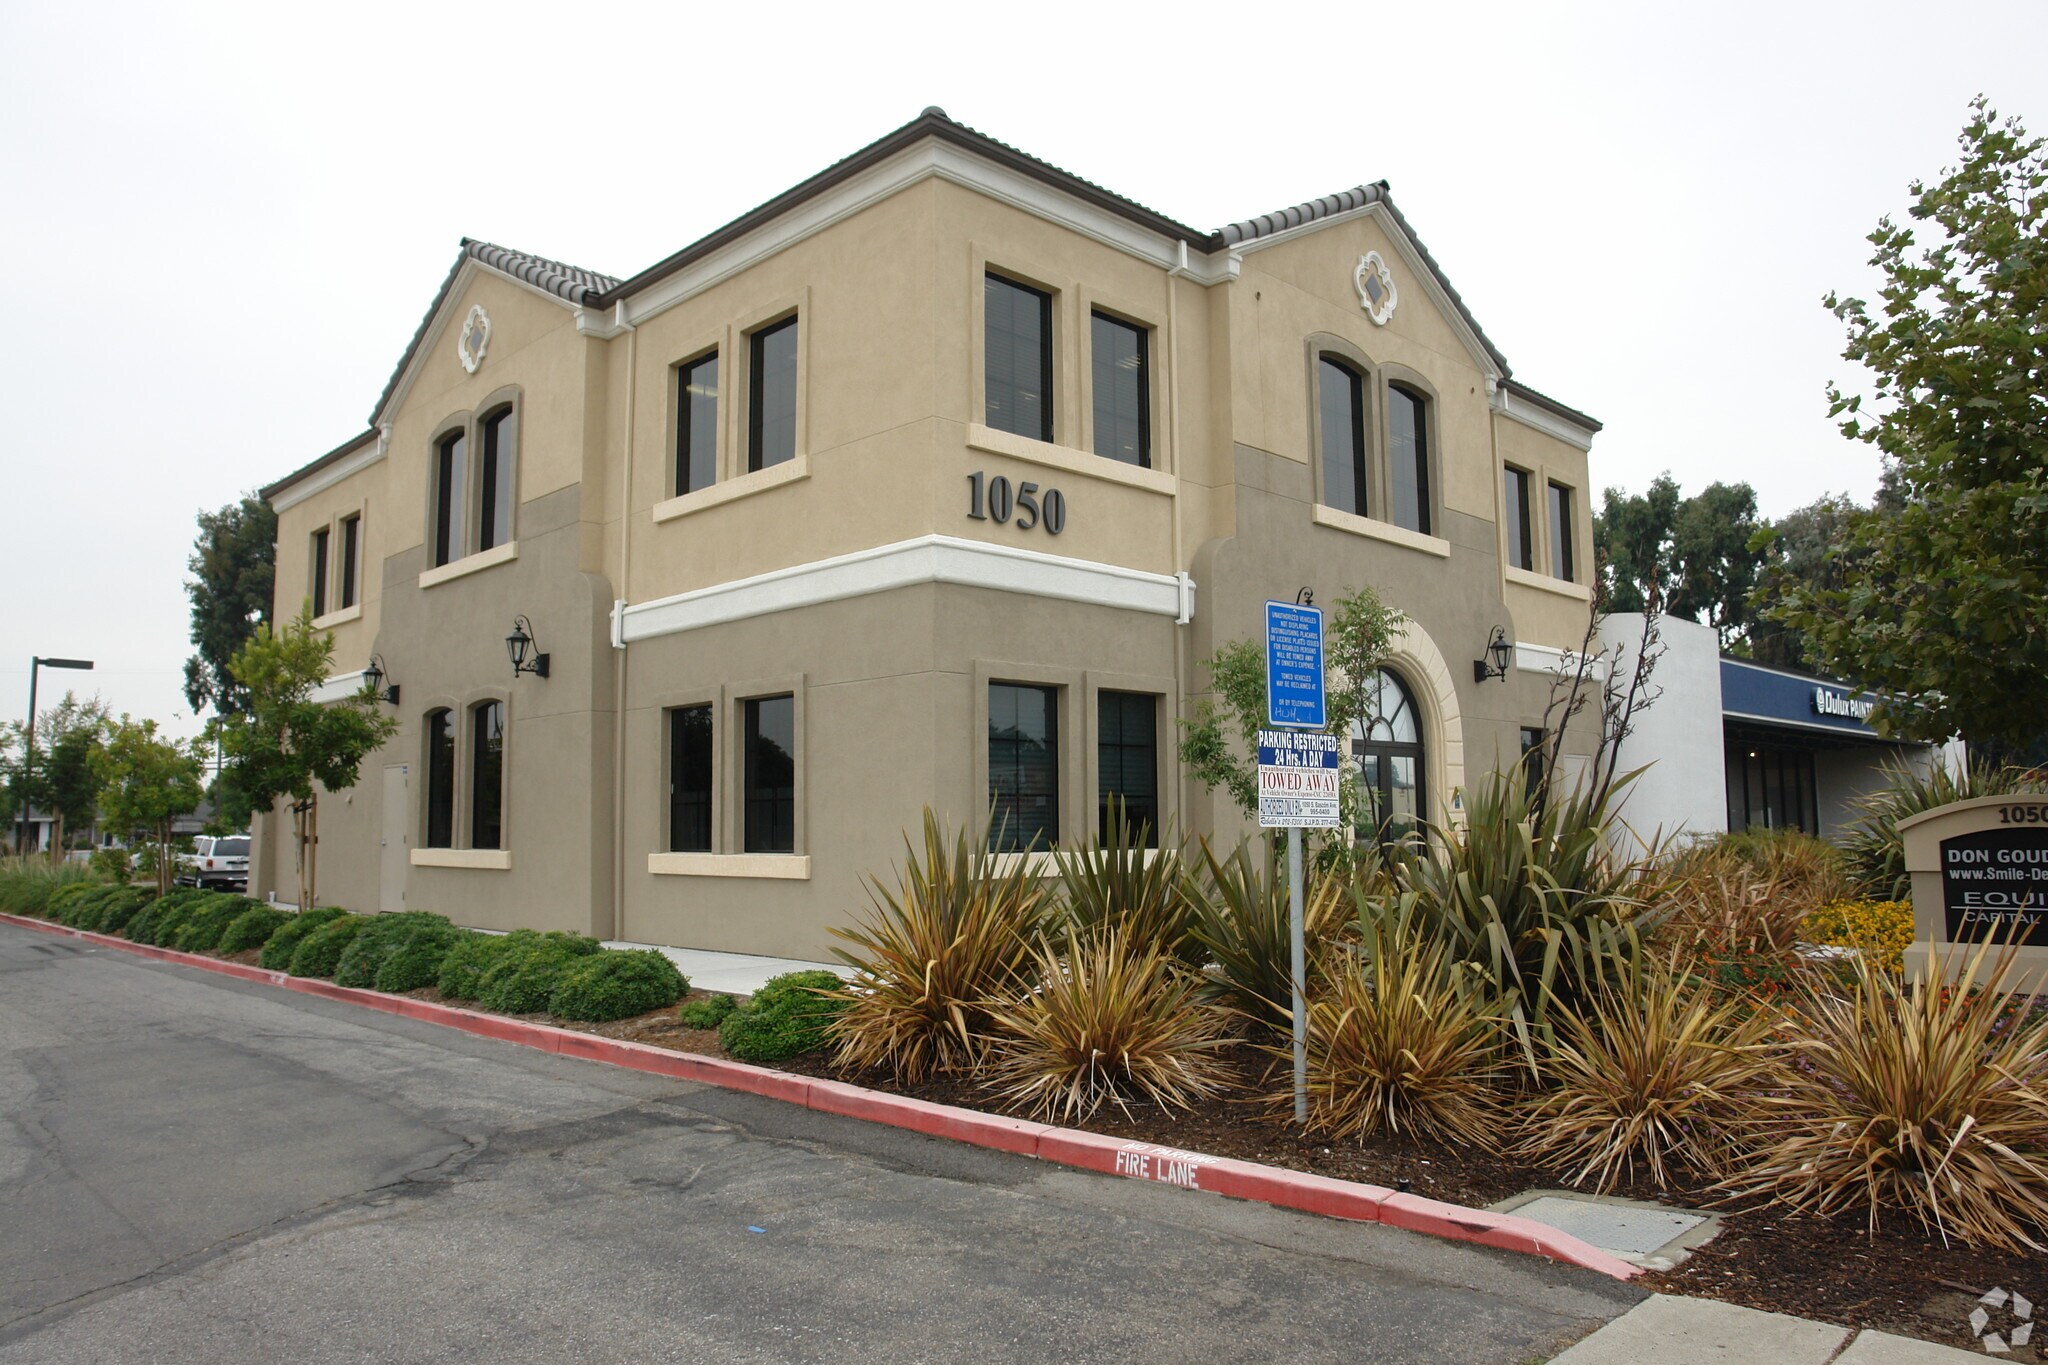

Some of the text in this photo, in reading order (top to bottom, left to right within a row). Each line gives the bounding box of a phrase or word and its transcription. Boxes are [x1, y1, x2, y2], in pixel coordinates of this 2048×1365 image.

[967, 471, 1066, 535] 1050
[1272, 611, 1317, 624] UNAUTHORIZED VEHICLES
[1288, 621, 1309, 630] DISPLAYING
[1271, 627, 1318, 639] DISTINGUISHING PLACARDS
[1276, 635, 1291, 644] LICENSE
[1292, 637, 1305, 645] PLATES
[1276, 651, 1285, 659] WILL
[1281, 644, 1299, 652] DISABLED
[1281, 672, 1311, 682] TOWED VEHICLES
[1825, 690, 1850, 717] Dulux
[1258, 730, 1337, 752] PARKING RESTRICTED
[1274, 748, 1324, 768] 24 Hrs. A DAY
[1260, 765, 1295, 773] Unauthorized
[1260, 772, 1337, 791] TOWED AWAY
[1260, 798, 1284, 815] AUTHORIZED
[1284, 799, 1295, 816] ONLY
[1948, 849, 1989, 863] DON
[1964, 891, 2048, 906] EQUI
[1122, 1142, 1220, 1164] NO PARKING
[1116, 1150, 1199, 1189] FIRE LANE
